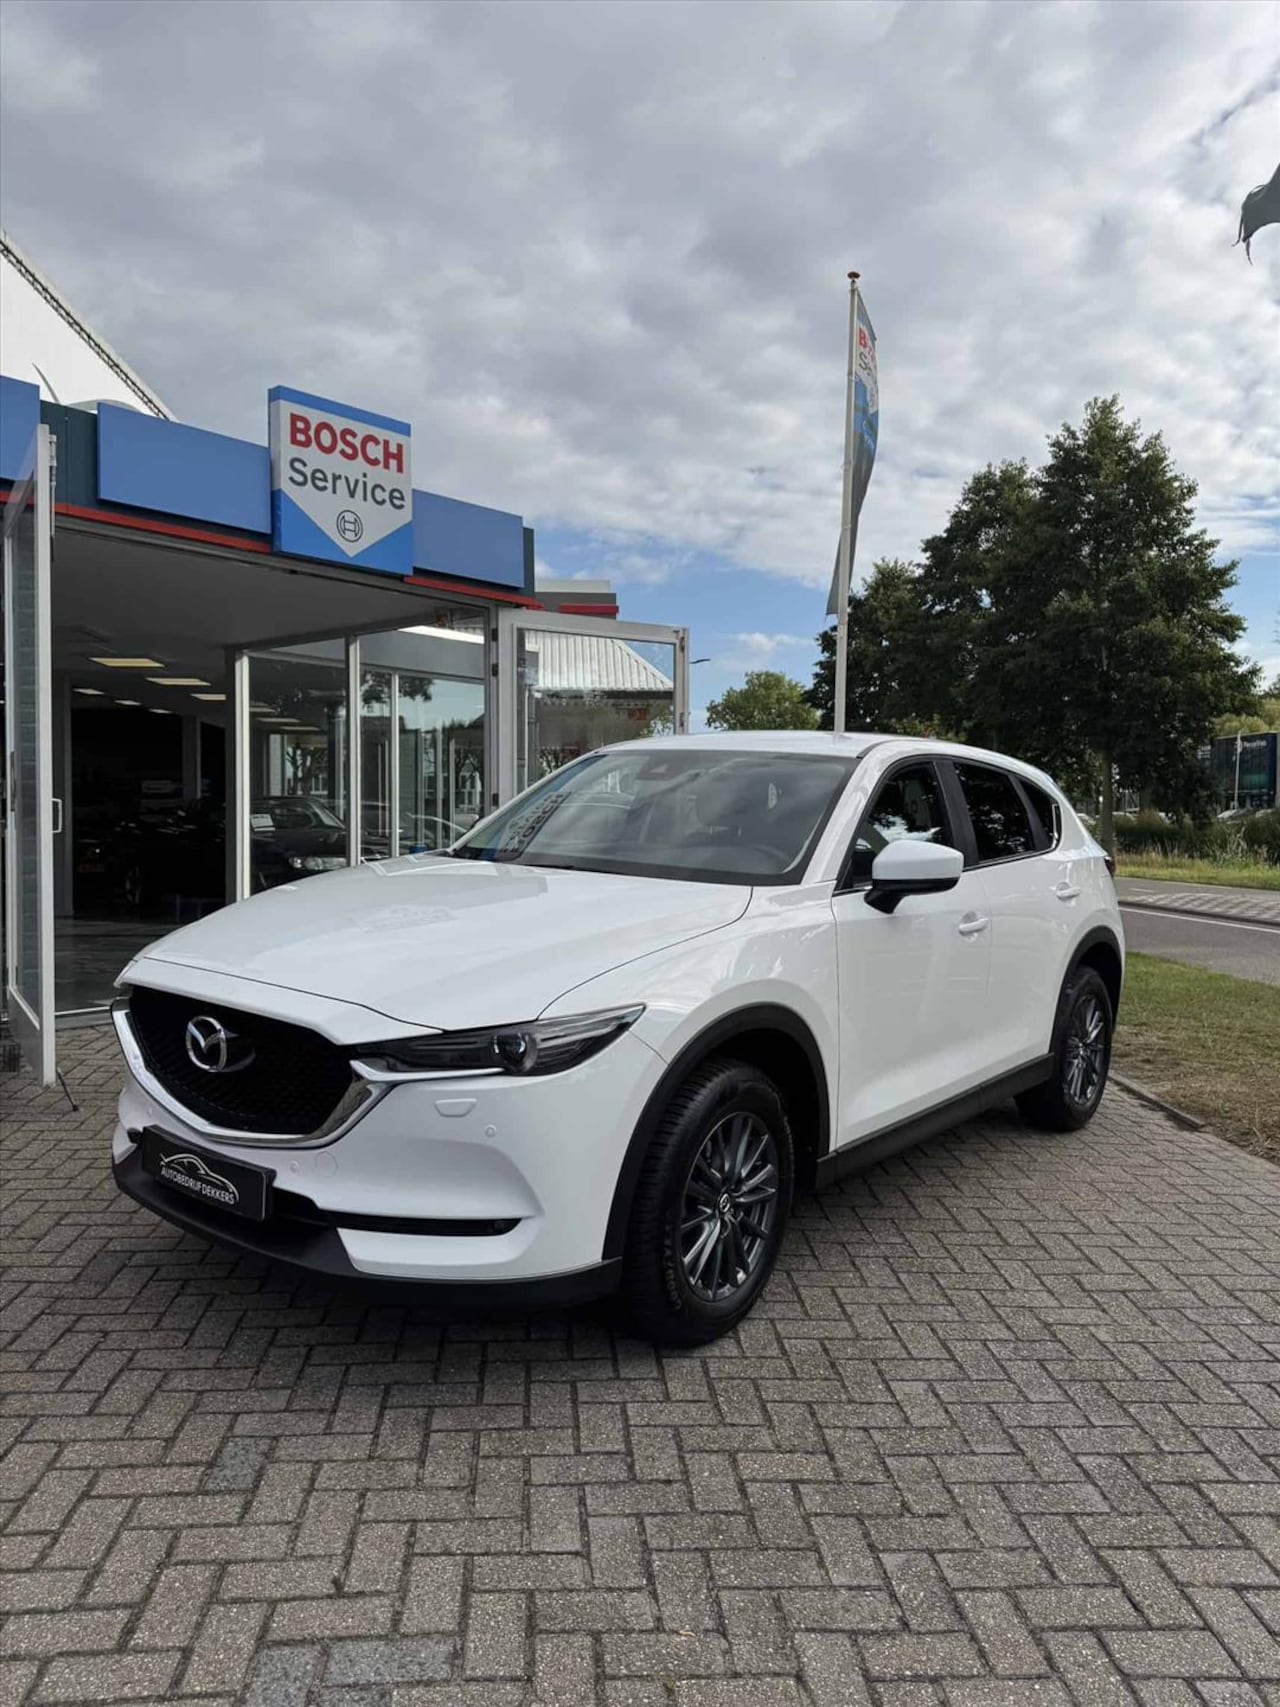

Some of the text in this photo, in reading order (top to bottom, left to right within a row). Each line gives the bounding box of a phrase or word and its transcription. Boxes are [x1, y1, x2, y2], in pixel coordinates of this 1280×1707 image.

[290, 413, 403, 474] BOSCH
[289, 456, 406, 511] Service
[161, 1167, 235, 1205] AUTOBEDRIJF DEKKERS
